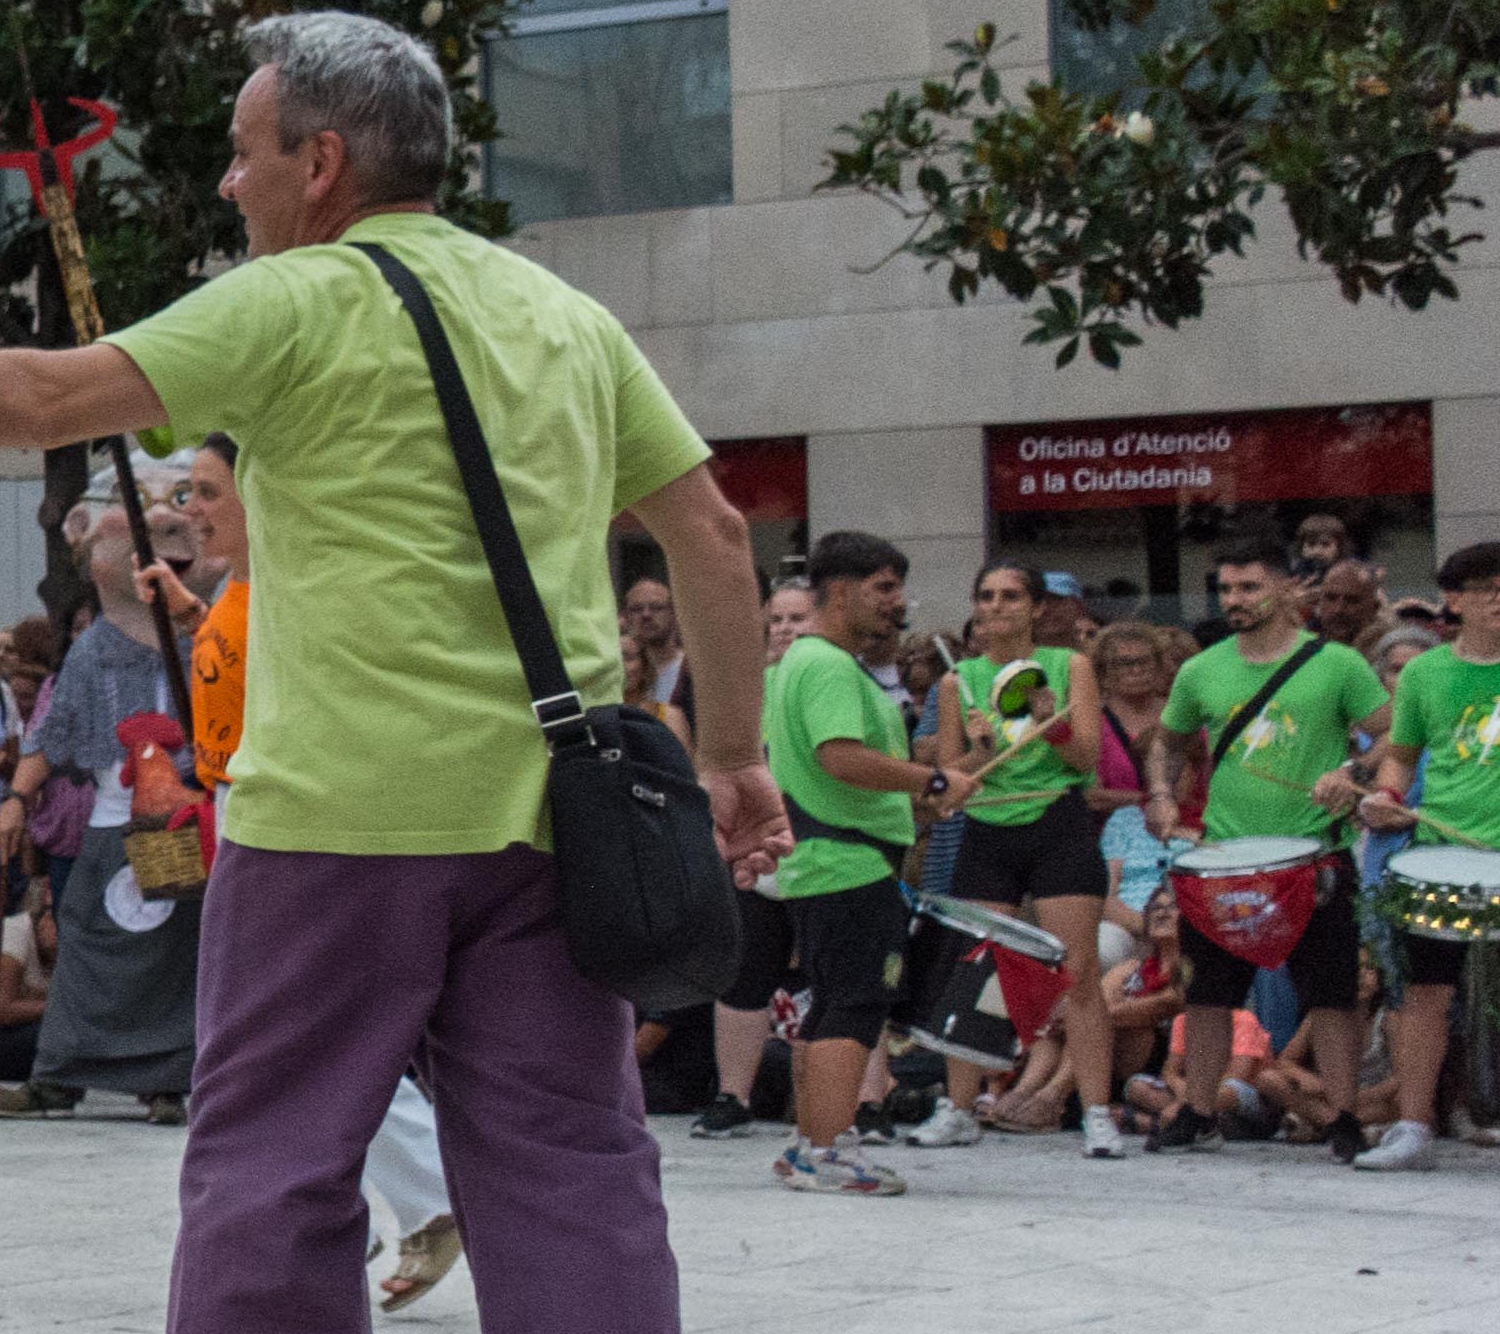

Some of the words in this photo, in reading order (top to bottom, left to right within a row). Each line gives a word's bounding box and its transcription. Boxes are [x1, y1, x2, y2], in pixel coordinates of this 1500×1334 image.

[1019, 436, 1106, 461] Oficina
[1112, 427, 1232, 457] d'Atenció
[1020, 474, 1037, 495] a
[1043, 470, 1066, 494] la
[1072, 463, 1213, 493] Ciutadania
